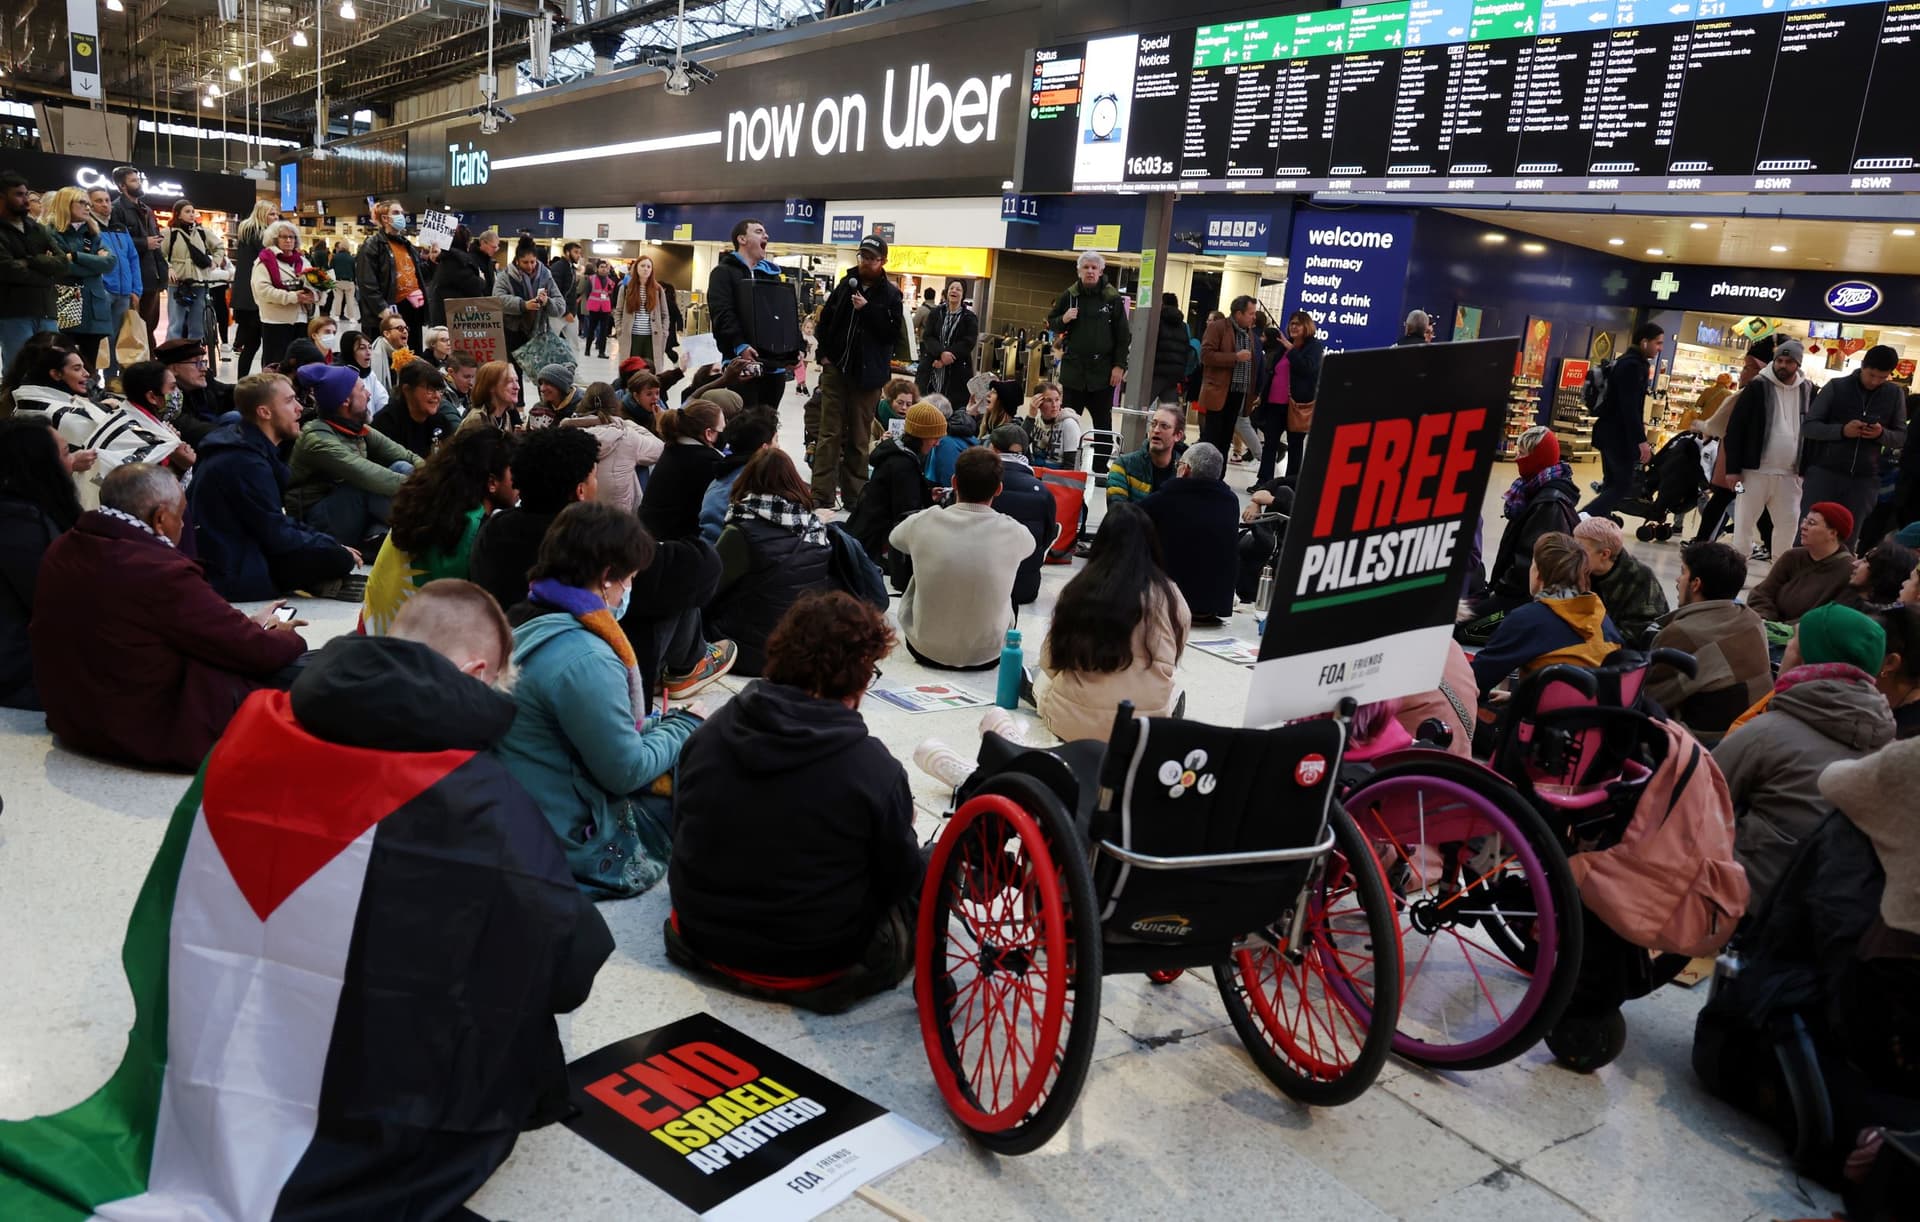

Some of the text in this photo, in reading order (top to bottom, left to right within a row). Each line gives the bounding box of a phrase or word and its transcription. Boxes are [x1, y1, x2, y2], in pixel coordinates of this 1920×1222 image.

[1141, 36, 1170, 51] Special
[1036, 52, 1058, 62] Status
[1139, 55, 1169, 66] Notices
[726, 64, 1012, 163] now on Uber
[449, 144, 488, 187] Trains
[1128, 157, 1173, 174] 16:03 25
[1597, 179, 1619, 189] SWR
[1676, 178, 1701, 188] SWR
[1764, 178, 1791, 188] SWR
[1861, 177, 1891, 188] SWR
[647, 208, 654, 219] 9
[798, 204, 813, 218] 10
[1003, 198, 1038, 216] 11 11
[426, 210, 447, 224] FREE
[548, 212, 555, 220] 8
[1208, 239, 1250, 248] Wide Platform Gate
[1309, 226, 1394, 249] welcome
[1306, 254, 1363, 272] pharmacy
[1304, 272, 1342, 289] beauty
[1301, 290, 1371, 308] food & drink
[1711, 282, 1786, 301] pharmacy
[1831, 287, 1872, 307] Boots
[453, 312, 491, 321] ALWAYS
[1328, 311, 1338, 323] &
[1340, 311, 1368, 326] child
[454, 338, 496, 349] CEASE
[1313, 408, 1487, 538] FREE
[1295, 520, 1461, 597] PALESTINE
[1318, 662, 1346, 687] FOA
[1131, 922, 1190, 936] QUICKIE
[583, 1041, 760, 1132] END
[648, 1077, 800, 1155] ISRAELI
[685, 1097, 826, 1175] APARTHEID
[786, 1171, 824, 1194] FOA
[816, 1148, 851, 1169] FRIENDS
